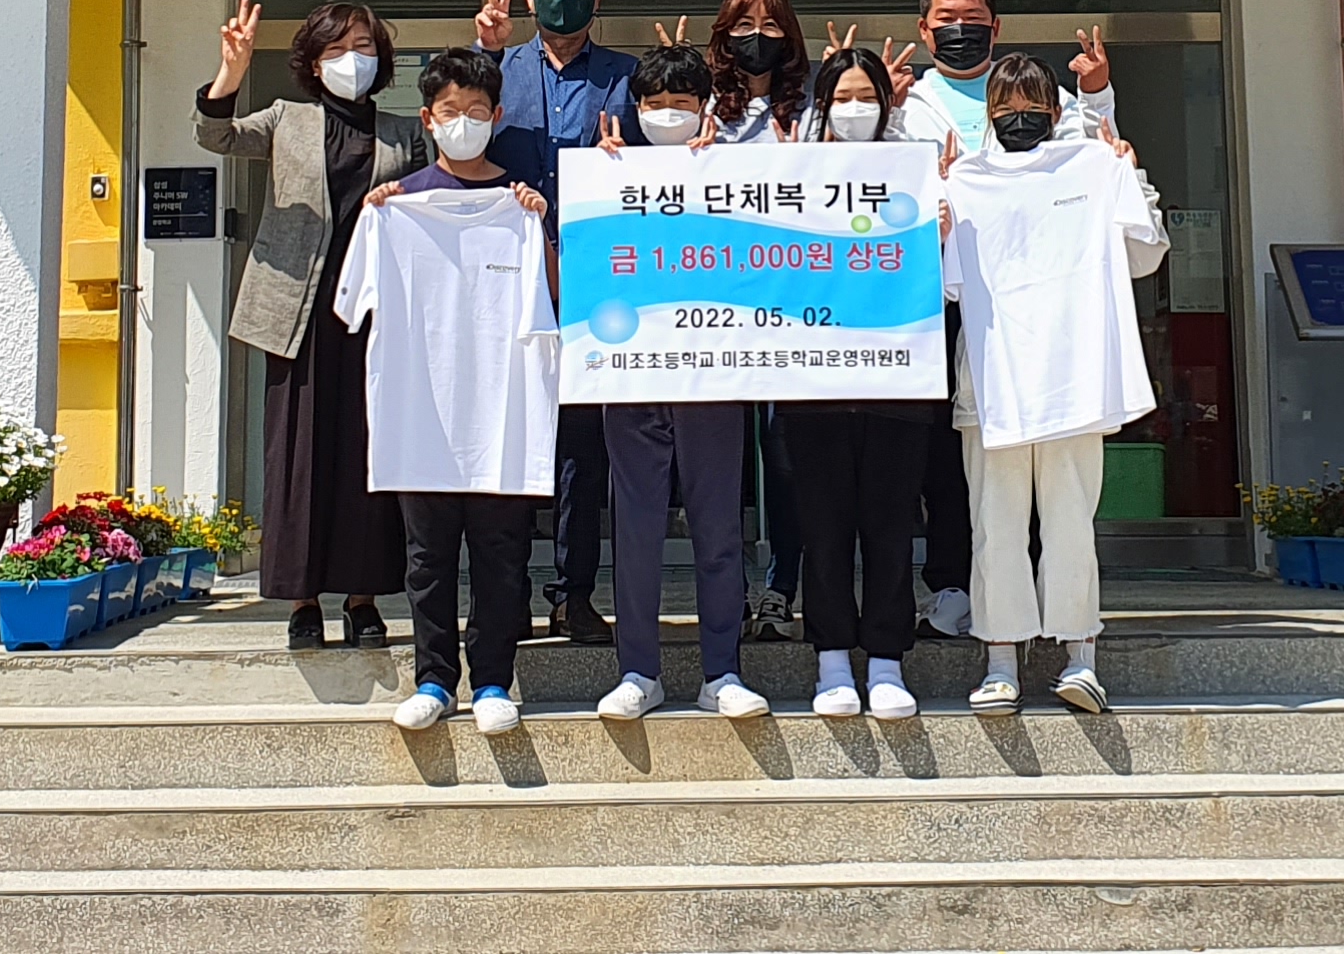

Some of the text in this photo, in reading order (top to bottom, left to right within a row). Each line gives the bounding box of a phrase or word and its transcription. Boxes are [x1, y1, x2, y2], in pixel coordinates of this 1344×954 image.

[619, 182, 891, 216] 학생 단체복 기부
[609, 241, 904, 274] 금 1,861,000원 상당
[674, 306, 841, 328] 2022. 05. 02.
